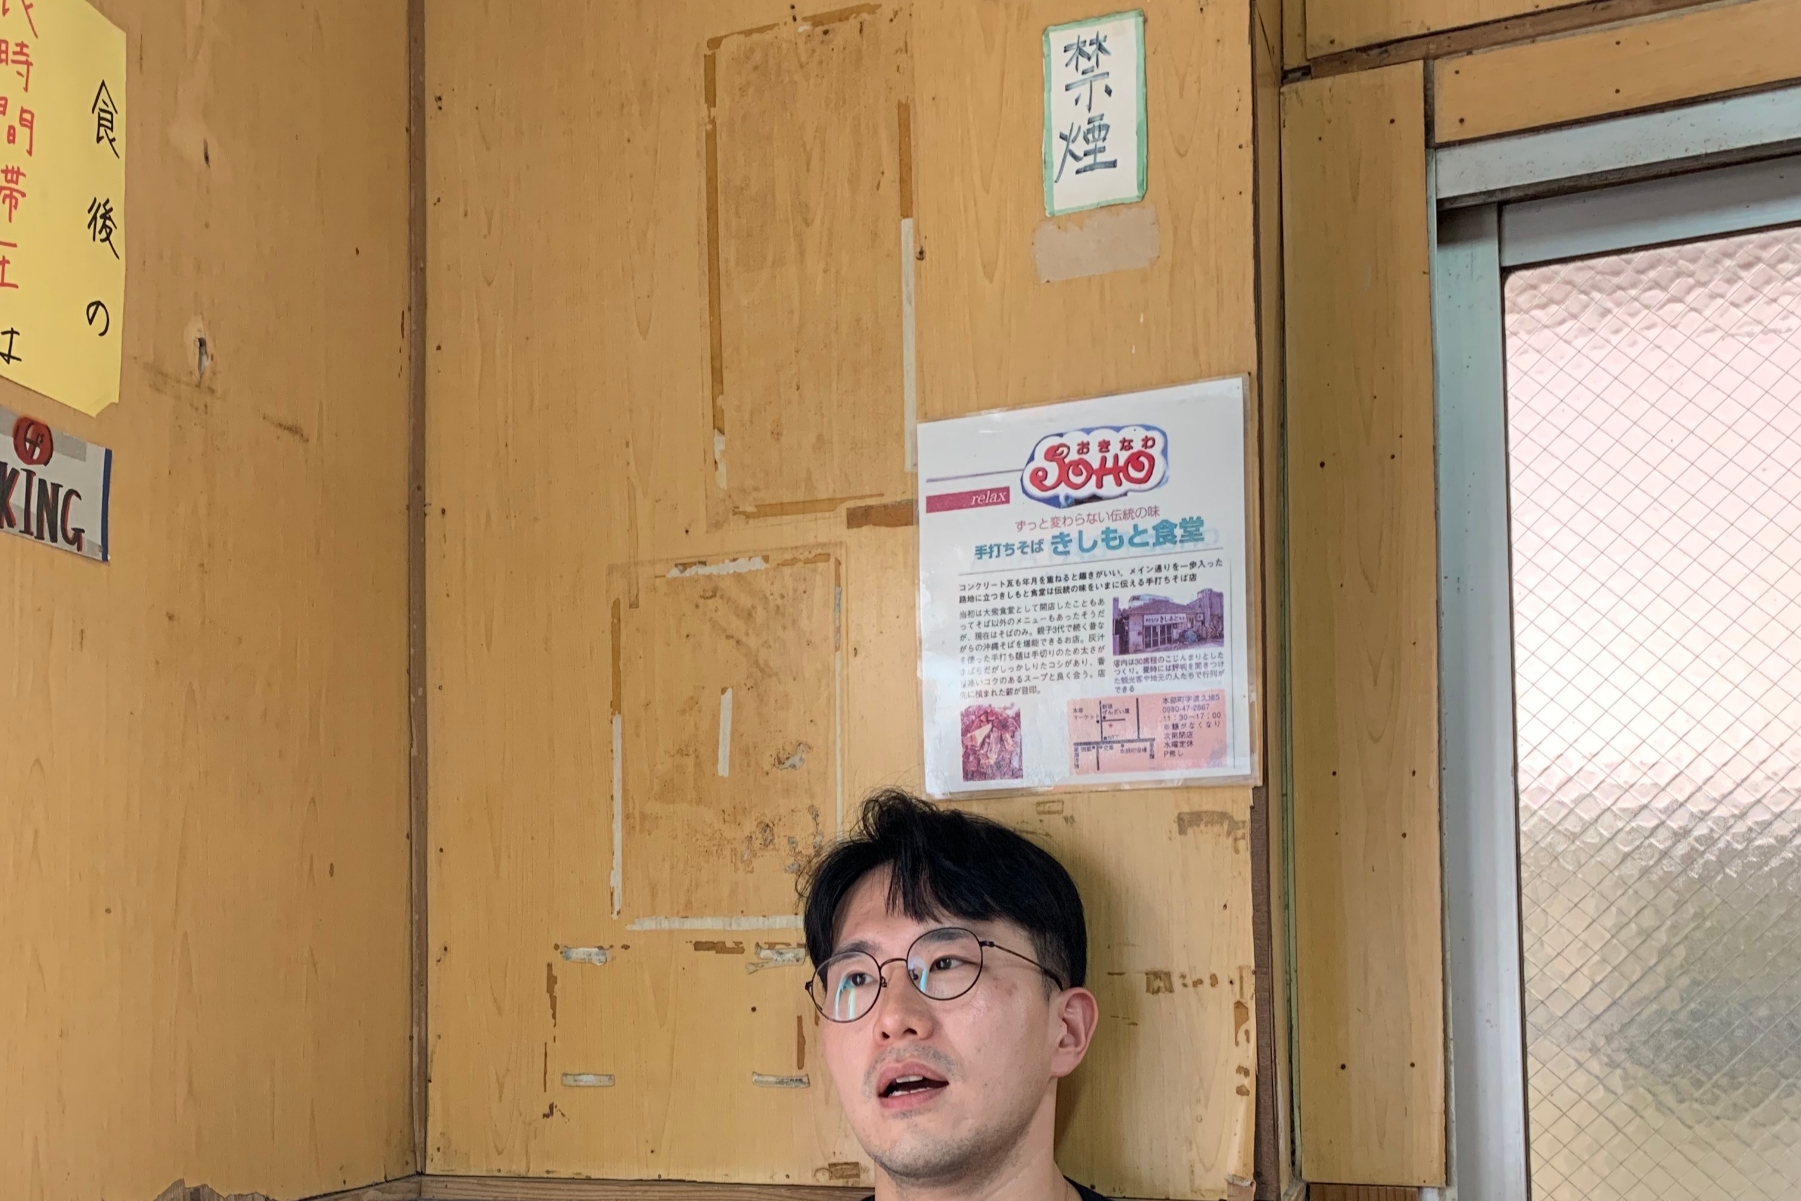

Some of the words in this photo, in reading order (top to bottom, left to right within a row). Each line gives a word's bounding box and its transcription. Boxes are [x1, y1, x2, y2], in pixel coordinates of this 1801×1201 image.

[1054, 30, 1118, 184] 禁煙
[86, 79, 121, 337] 食後の
[1076, 435, 1156, 455] おきなわ
[970, 489, 1007, 506] relax
[1014, 505, 1160, 533] ずっと変わらない伝統の味
[974, 538, 1044, 560] 手打ちそば
[1050, 516, 1205, 557] きしもと食堂
